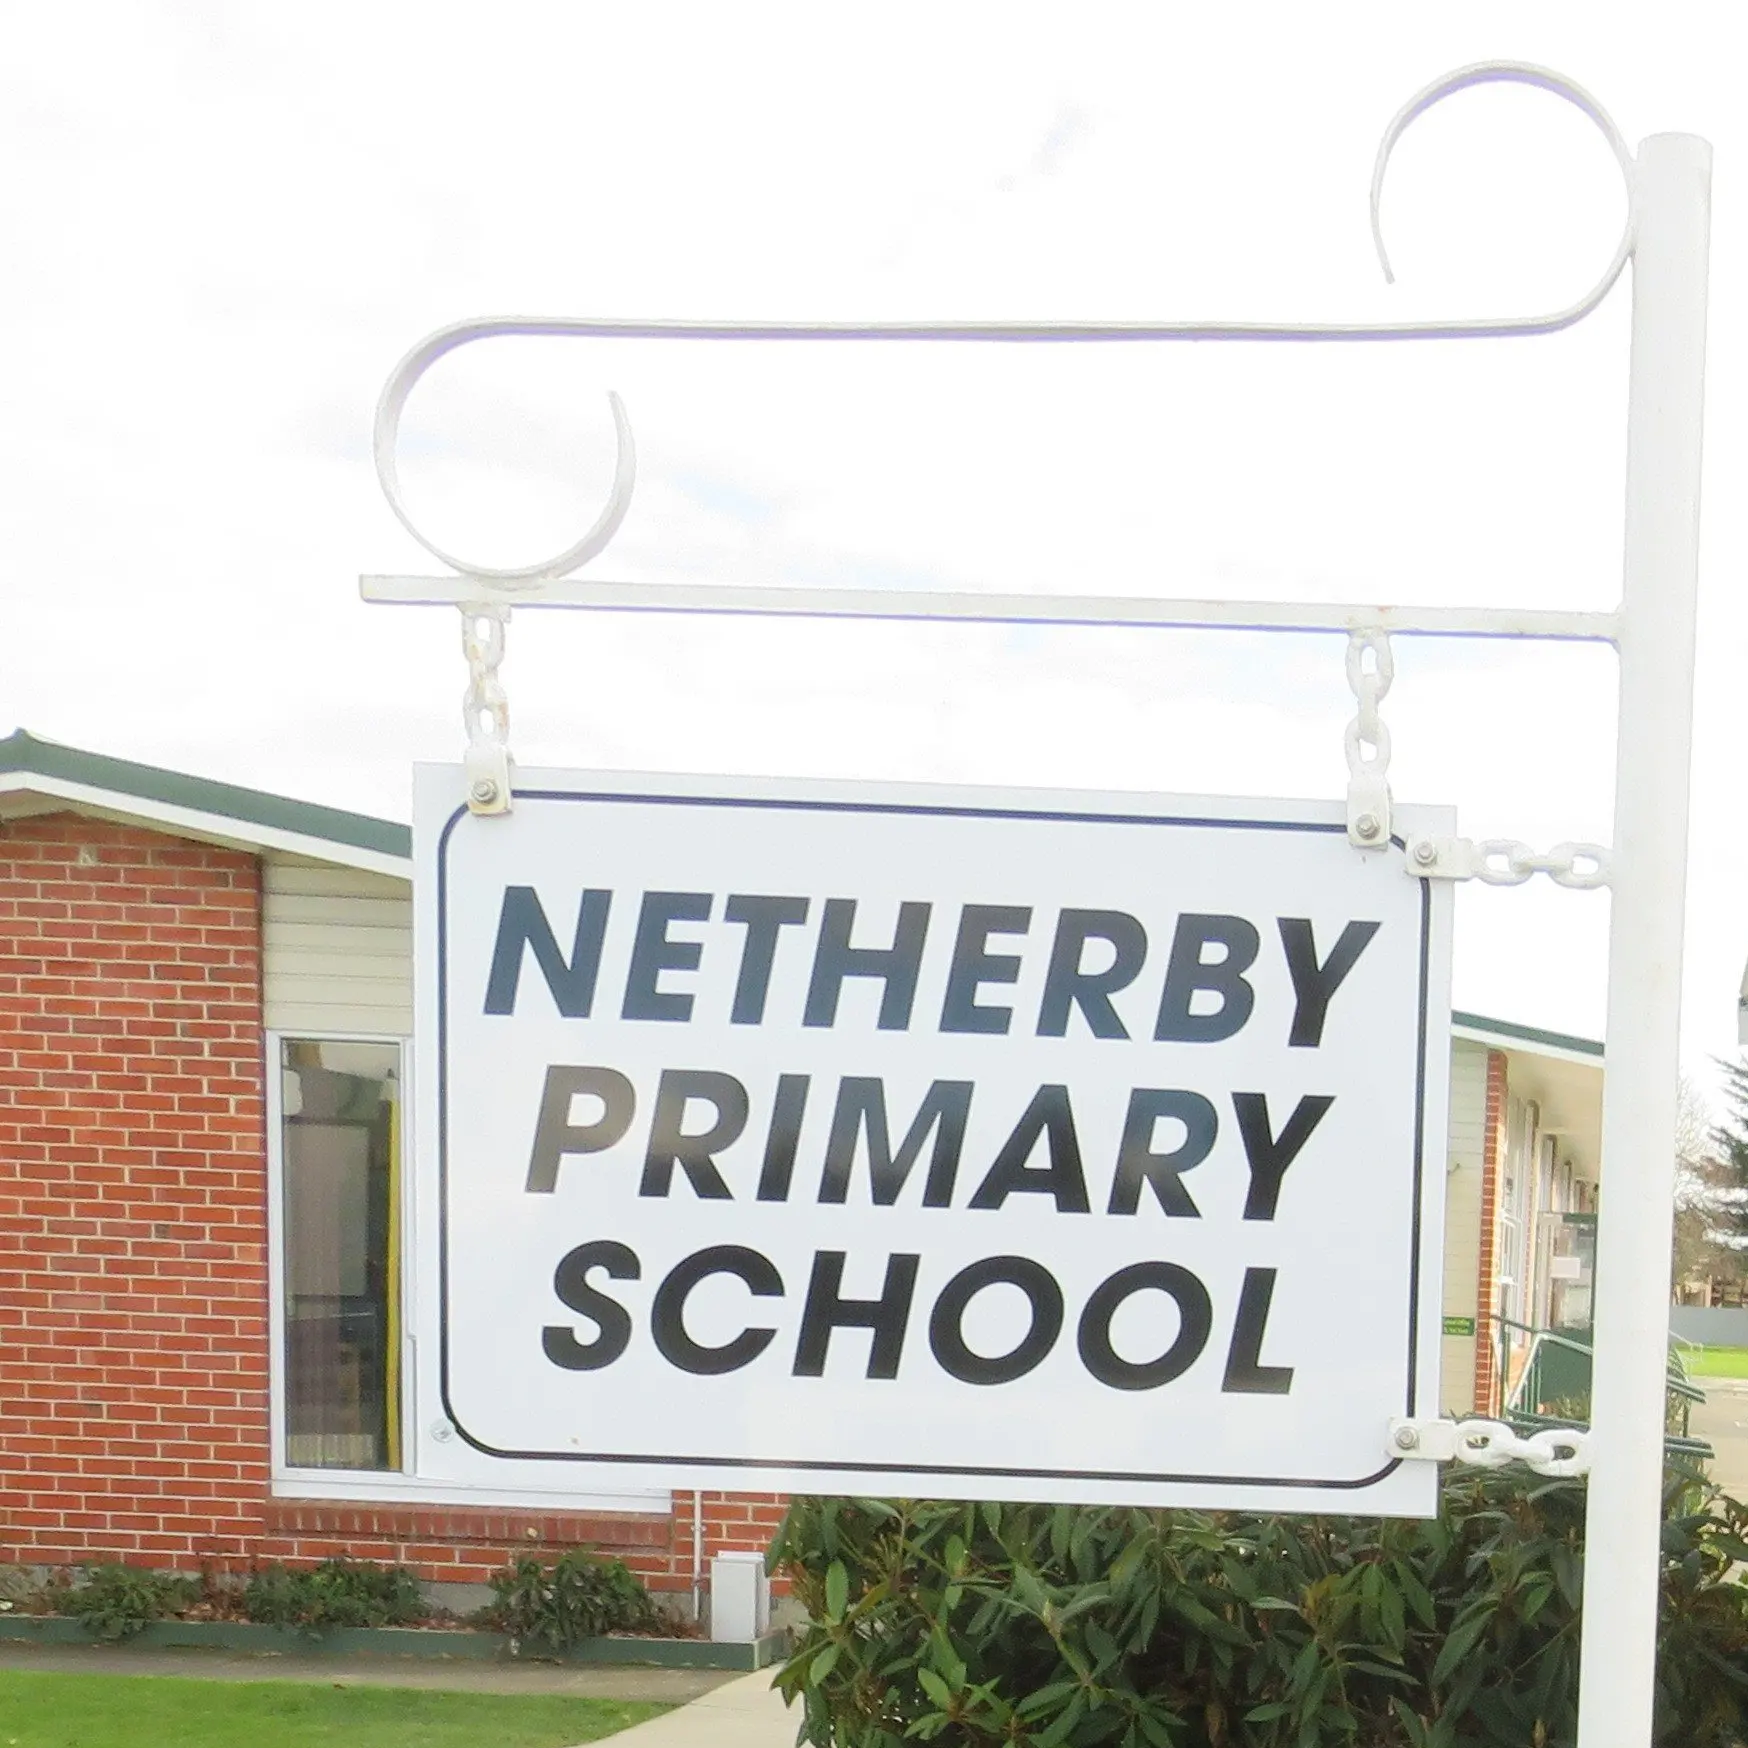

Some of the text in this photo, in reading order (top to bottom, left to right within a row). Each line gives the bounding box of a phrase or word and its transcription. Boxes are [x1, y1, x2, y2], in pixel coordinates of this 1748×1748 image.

[485, 886, 1380, 1047] NETHERBY
[526, 1065, 1335, 1221] PRIMARY
[541, 1240, 1293, 1393] SCHOOL
